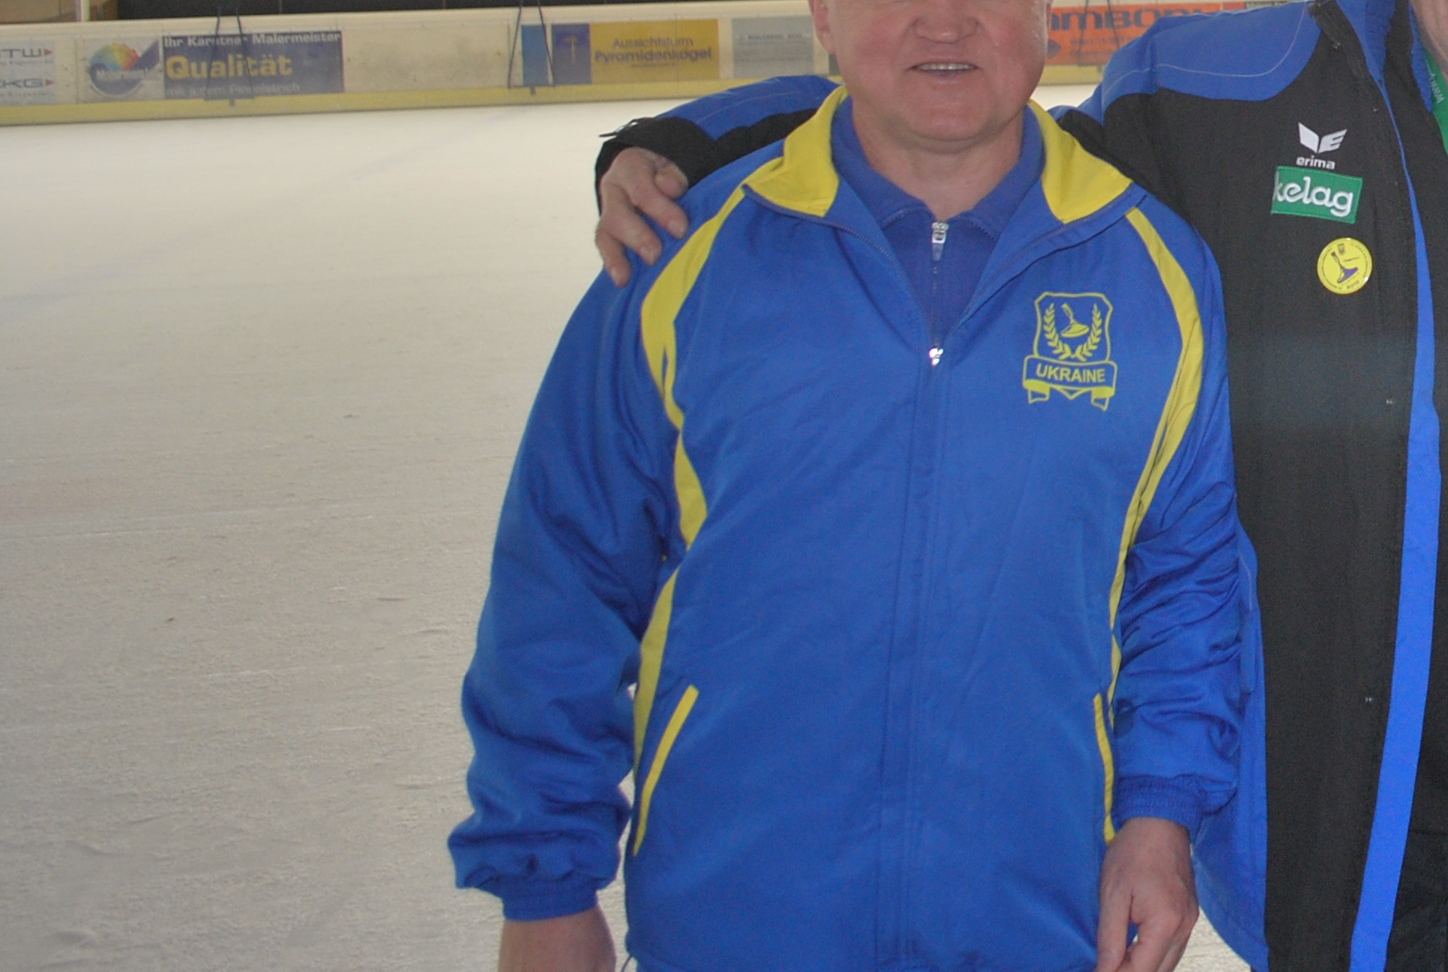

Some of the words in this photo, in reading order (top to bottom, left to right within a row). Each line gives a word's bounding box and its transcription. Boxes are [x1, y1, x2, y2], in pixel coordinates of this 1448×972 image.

[164, 36, 185, 48] Ihr
[252, 32, 341, 45] Malermeister
[613, 35, 694, 50] Aussichtsturm
[595, 46, 712, 64] Pyramidenkogel
[165, 53, 294, 80] Qualität
[1296, 155, 1336, 170] erima
[1273, 176, 1354, 217] kelag
[1036, 363, 1106, 383] UKRAINE
